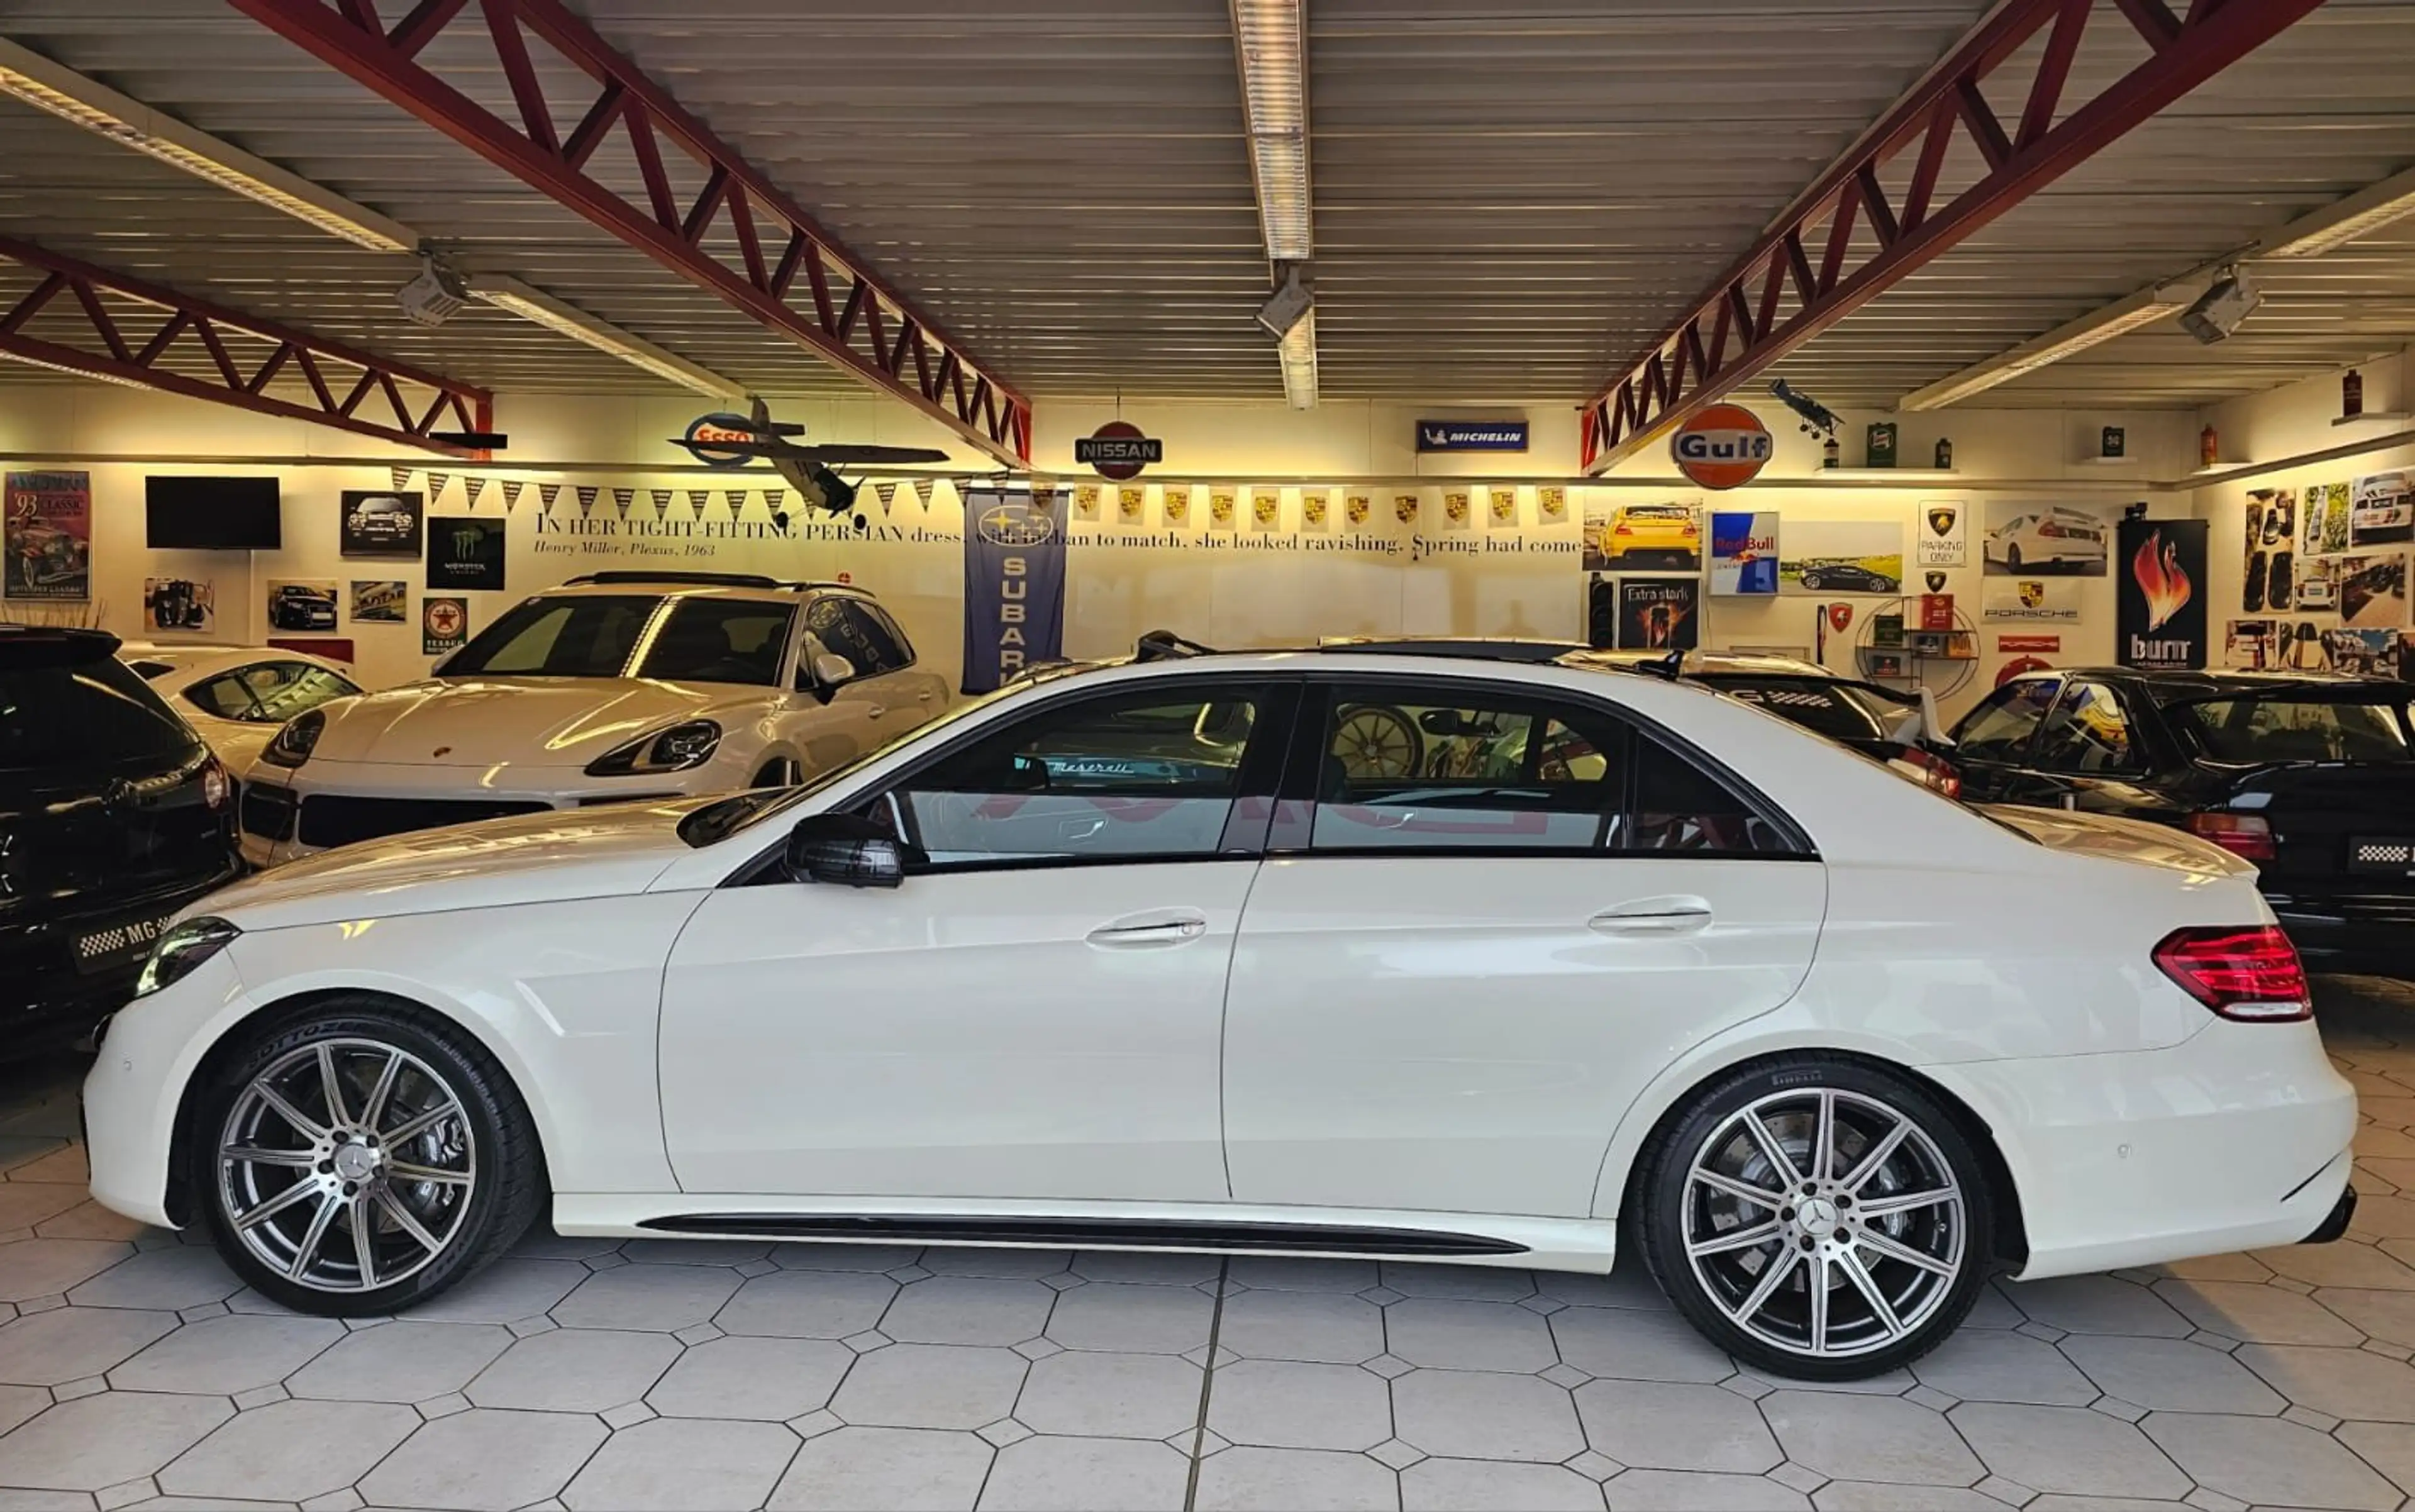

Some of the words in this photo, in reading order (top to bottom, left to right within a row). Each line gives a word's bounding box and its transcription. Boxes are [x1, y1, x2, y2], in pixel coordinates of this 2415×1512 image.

[1450, 432, 1521, 442] MICHELIN
[1082, 443, 1157, 458] NISSAN
[1680, 434, 1767, 458] Gulf
[570, 519, 616, 535] HER
[624, 520, 797, 540] TIGHT-FITTING
[806, 524, 904, 542] PERSIAN
[1097, 533, 1114, 547] to
[1195, 532, 1226, 548] she
[1233, 532, 1297, 550] looked
[1413, 533, 1479, 557] Spring
[1485, 535, 1523, 552] had
[1530, 540, 1582, 553] come
[1748, 536, 1774, 550] Bull
[535, 540, 577, 556] Henry
[684, 544, 716, 557] 1963
[1921, 541, 1963, 551] PARKING
[1930, 553, 1953, 562] ONLY
[1628, 587, 1657, 602] Extra
[1984, 609, 2078, 618] PORSCHE
[125, 921, 157, 944] MG
